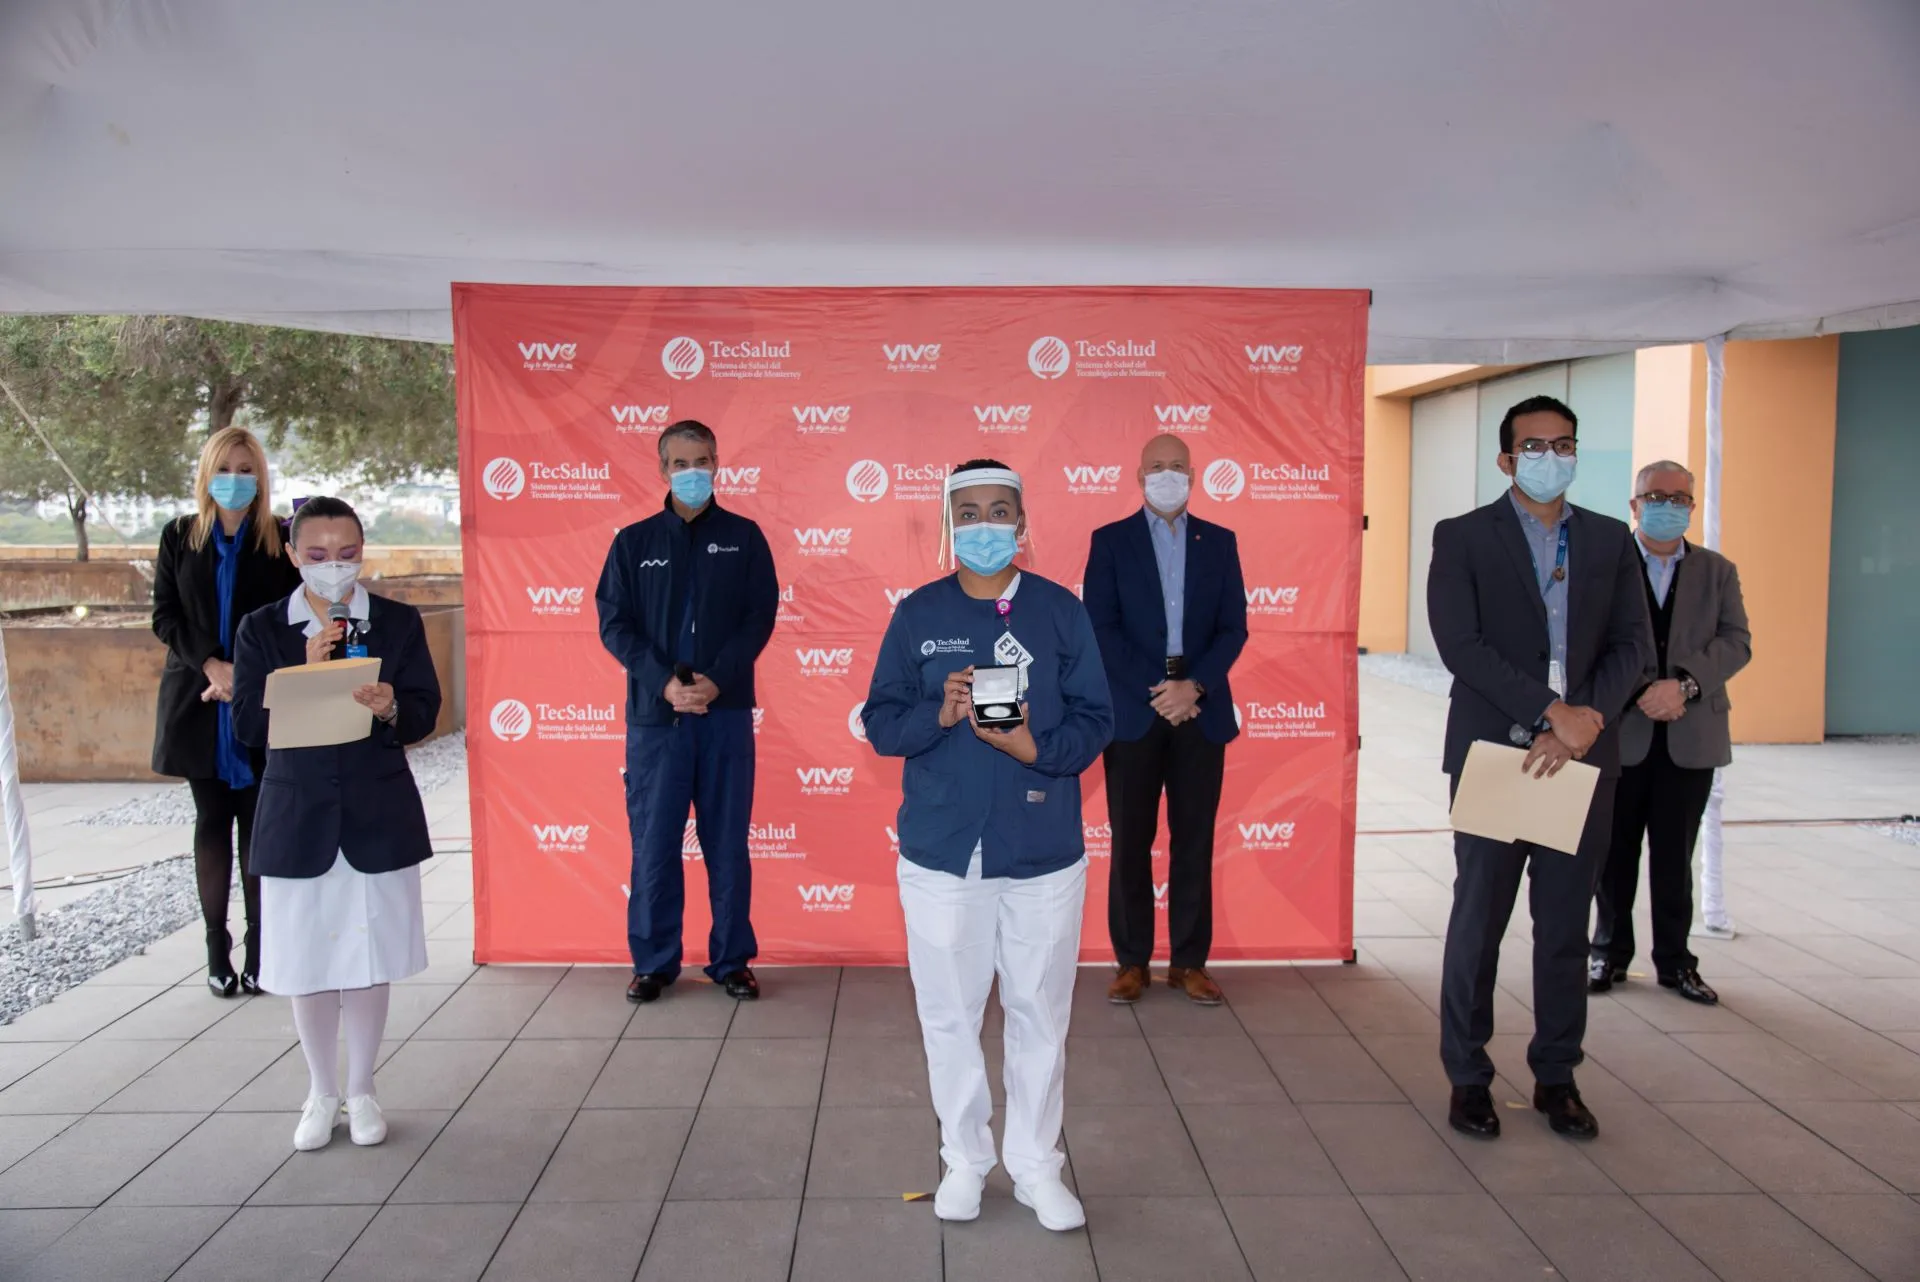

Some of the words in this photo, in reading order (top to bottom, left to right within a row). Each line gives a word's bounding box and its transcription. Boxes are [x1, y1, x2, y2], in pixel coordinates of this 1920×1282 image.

[709, 340, 791, 358] TecSalud
[1075, 339, 1156, 357] TecSalud
[528, 462, 610, 479] TecSalud
[1249, 463, 1330, 480] TecSalud
[936, 638, 970, 646] TecSalud
[536, 704, 616, 720] TecSalud
[1247, 702, 1325, 718] TecSalud
[748, 822, 796, 840] Salud
